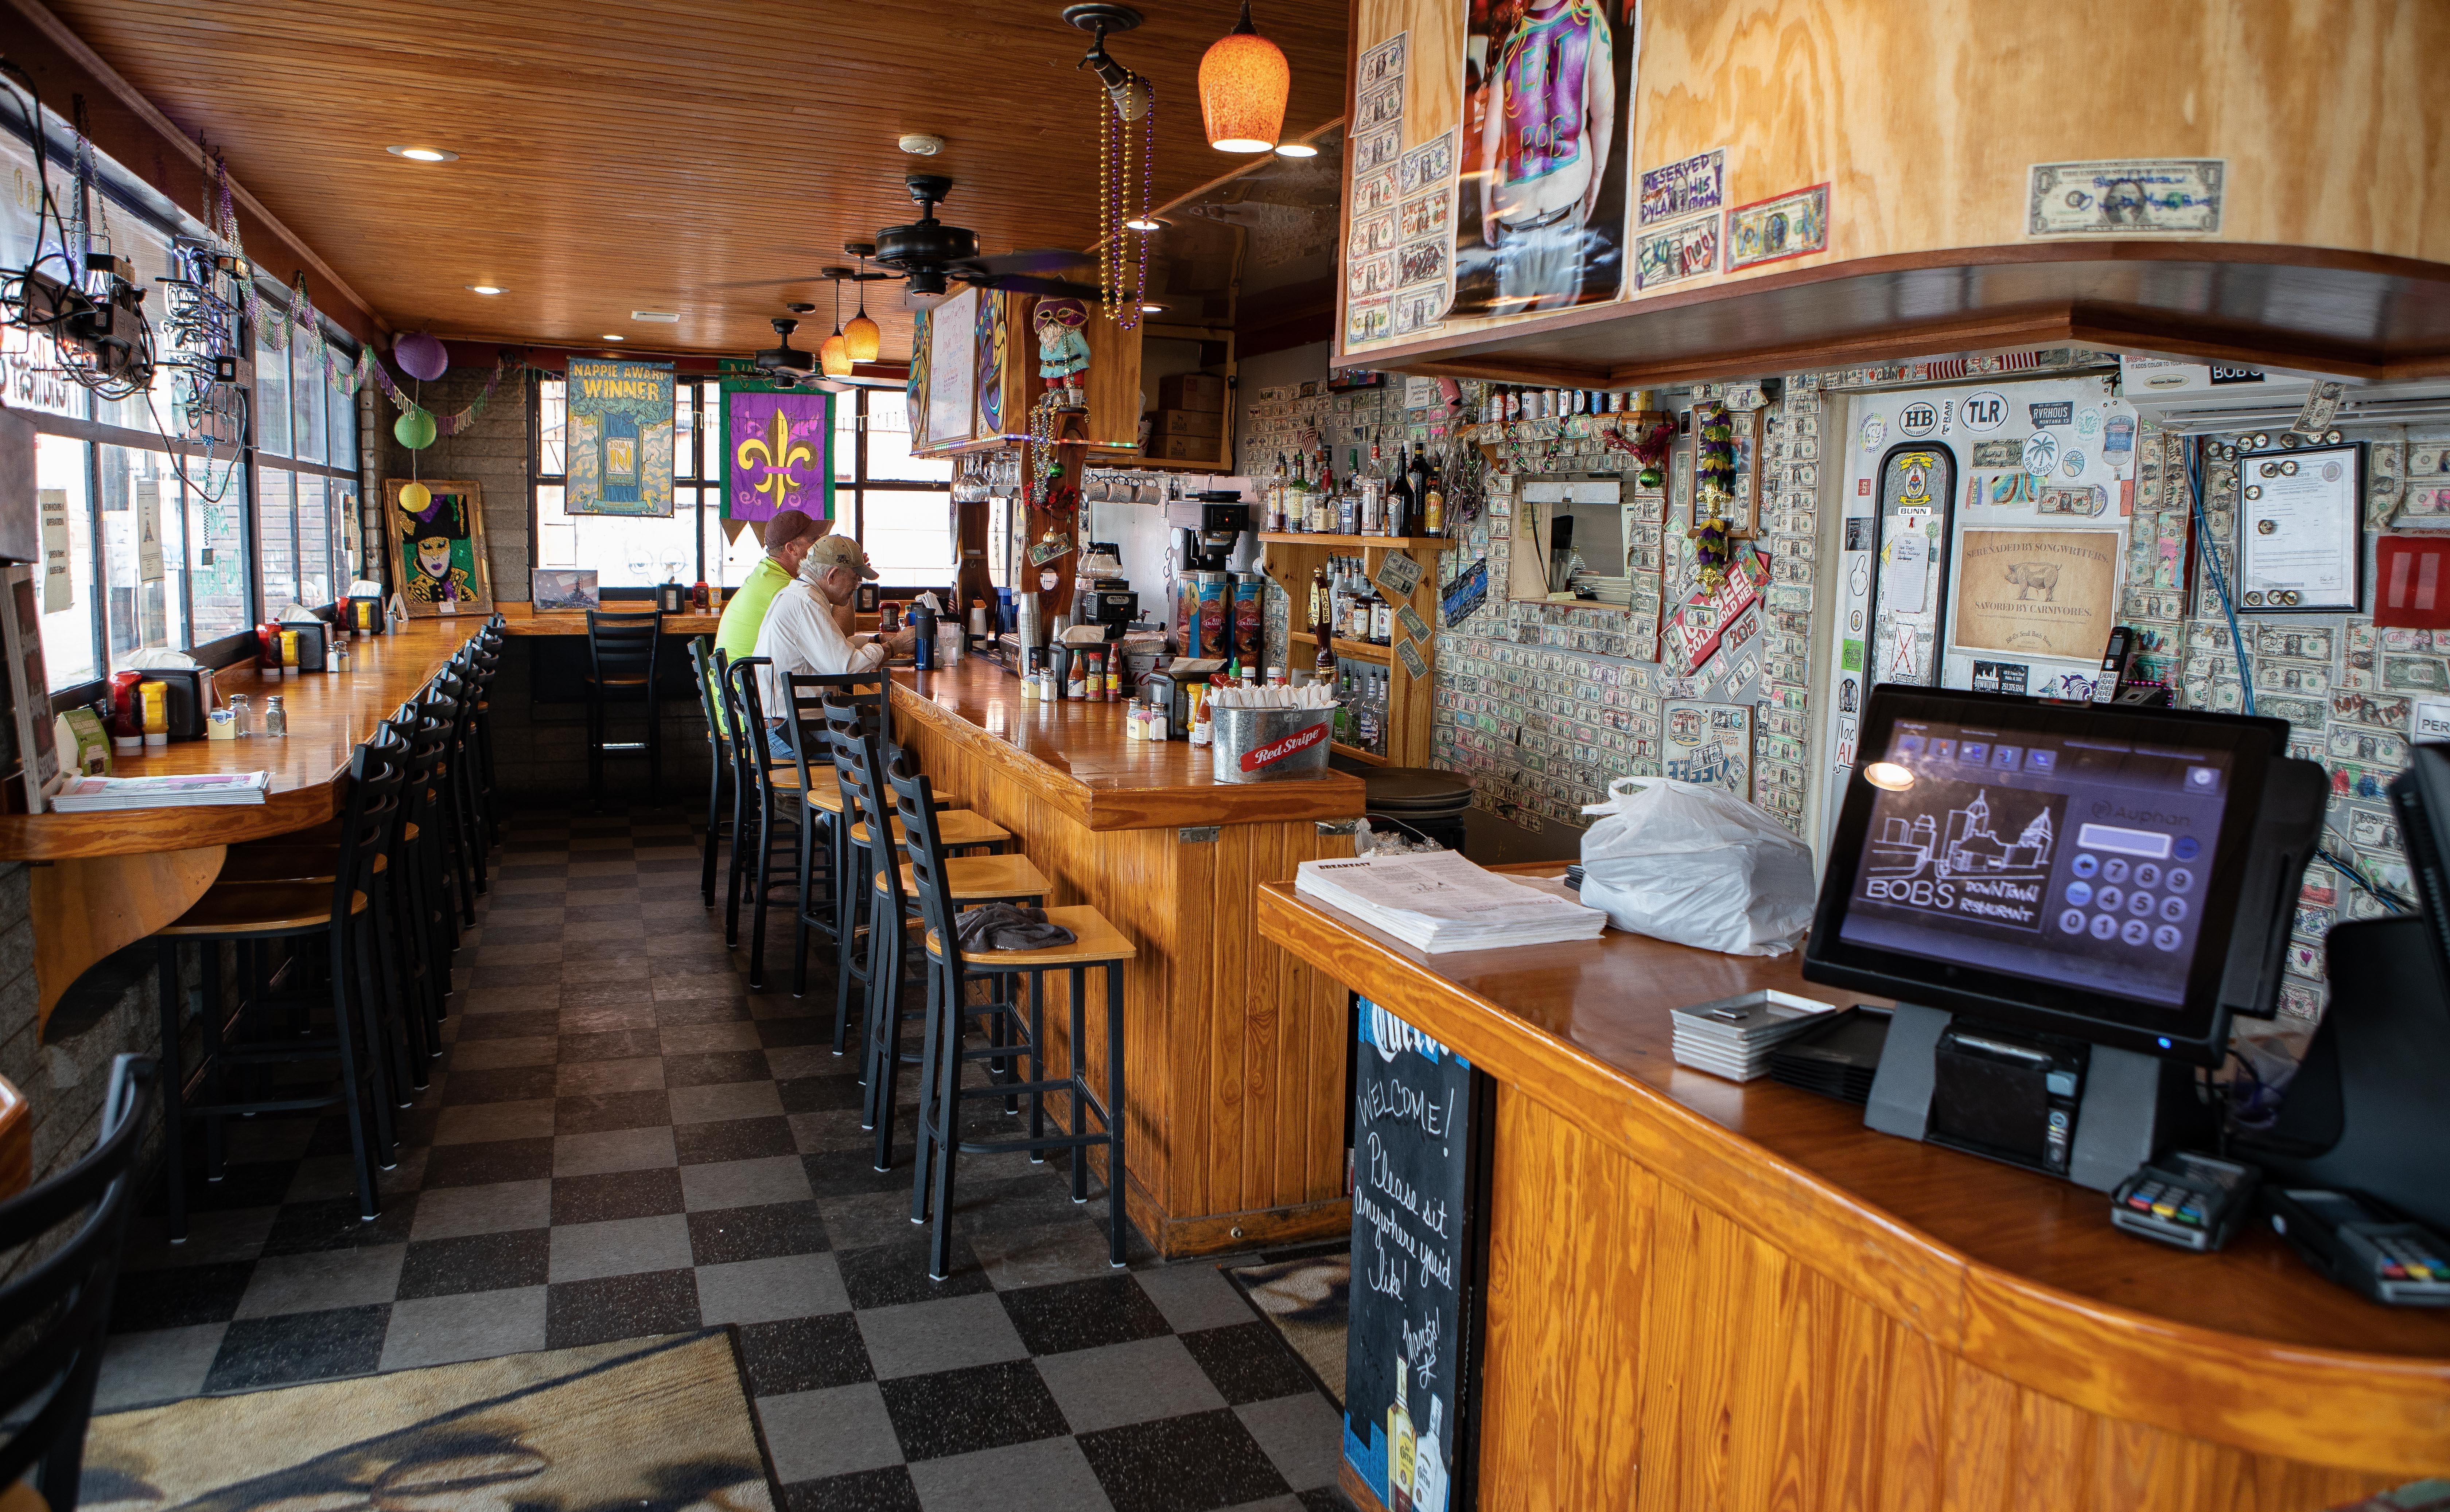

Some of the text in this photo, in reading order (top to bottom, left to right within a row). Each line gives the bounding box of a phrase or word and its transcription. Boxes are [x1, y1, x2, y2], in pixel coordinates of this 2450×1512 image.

[1520, 28, 1573, 94] EAT
[574, 364, 618, 378] NAPPIE
[583, 379, 659, 401] WINNER
[1905, 410, 1933, 428] HB
[1969, 400, 2000, 423] TLR
[2033, 407, 2068, 418] RVRHOUS
[2025, 457, 2053, 475] OUR COFFEE
[1967, 542, 2109, 563] SERENADED BY SONGWRITERS.
[1975, 601, 2092, 617] SAVORED BY CARNIVORES.
[1461, 679, 1475, 693] PPC
[1974, 679, 1999, 690] DOWNTOWN
[1840, 720, 1854, 741] loc
[1255, 729, 1319, 764] Red Stripe
[1837, 742, 1855, 765] AL
[2111, 863, 2124, 878] 7
[2142, 868, 2154, 882] 8
[2174, 873, 2186, 888] 9
[1866, 877, 1957, 908] BOB'S
[2102, 892, 2116, 907] 4
[2136, 897, 2148, 911] 5
[2167, 902, 2180, 916] 6
[2066, 914, 2079, 928] 0
[2100, 919, 2108, 934] 1
[2128, 925, 2142, 940] 2
[2160, 930, 2174, 945] 3
[1358, 1078, 1454, 1157] WELCOME!
[1368, 1132, 1448, 1239] Please sit
